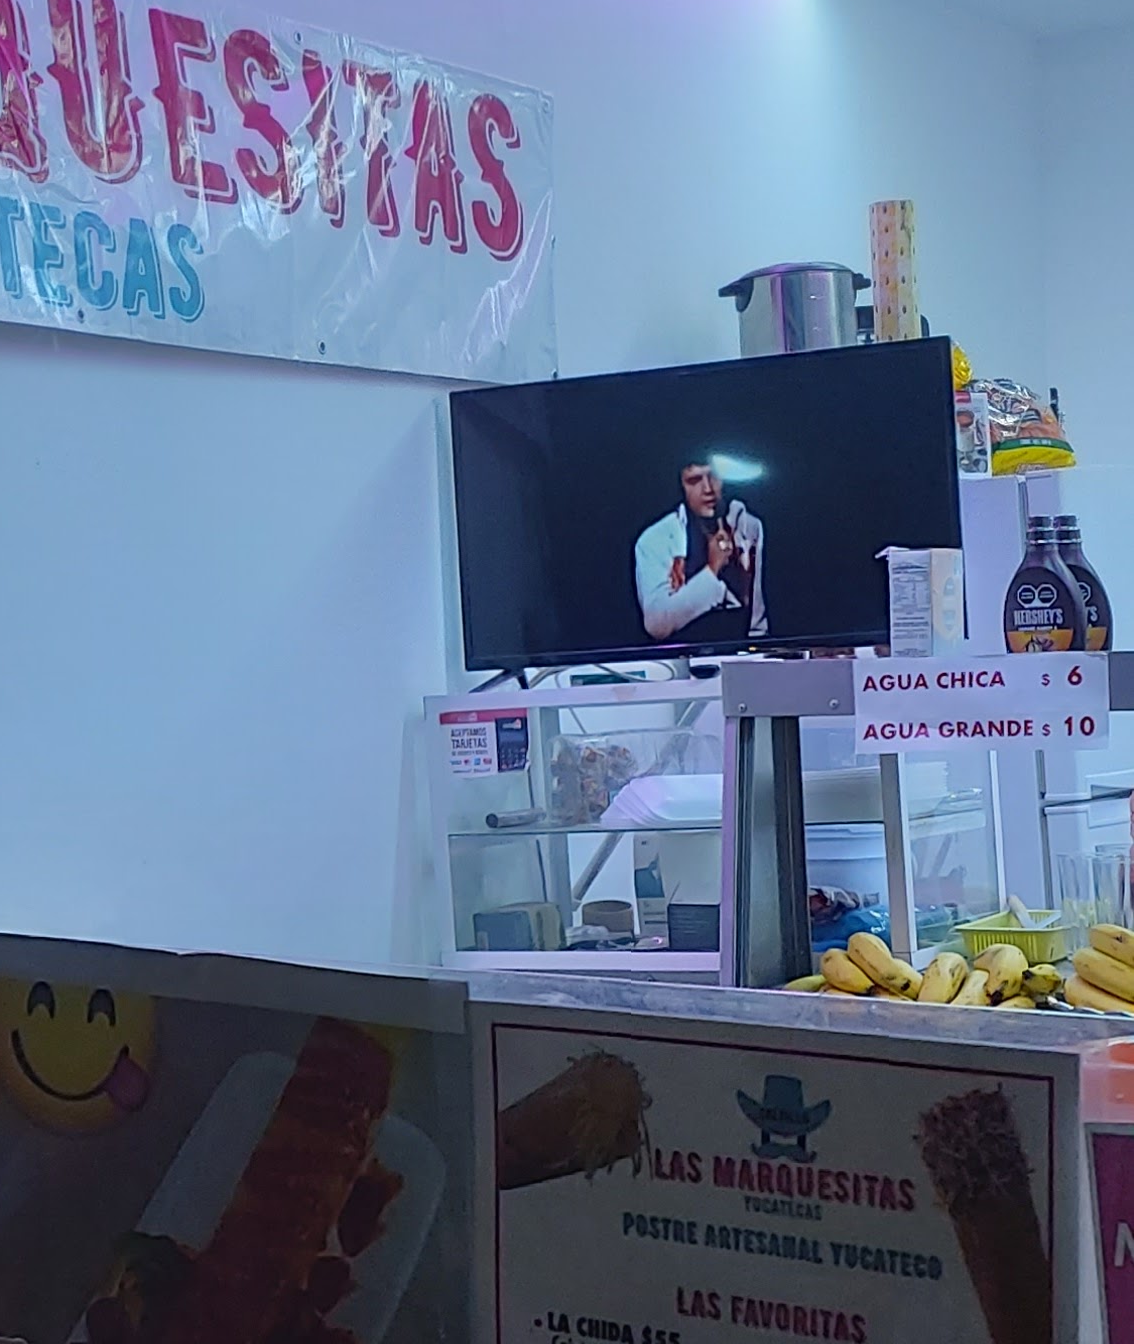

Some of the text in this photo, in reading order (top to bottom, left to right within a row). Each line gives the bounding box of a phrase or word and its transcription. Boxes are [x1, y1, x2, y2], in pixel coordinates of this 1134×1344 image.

[1013, 608, 1063, 625] HERSHEY'S
[863, 665, 1083, 692] AGUA CHICA $ 6
[863, 716, 1095, 740] AGUA GRANDE $ 10
[451, 737, 488, 749] TARJETAS
[654, 1147, 915, 1212] LAS MARQUESITAS
[622, 1211, 943, 1281] POSTRE ARTESANAL YUCATECO
[547, 1311, 570, 1334] LA
[675, 1285, 867, 1344] LAS FAVORITAS
